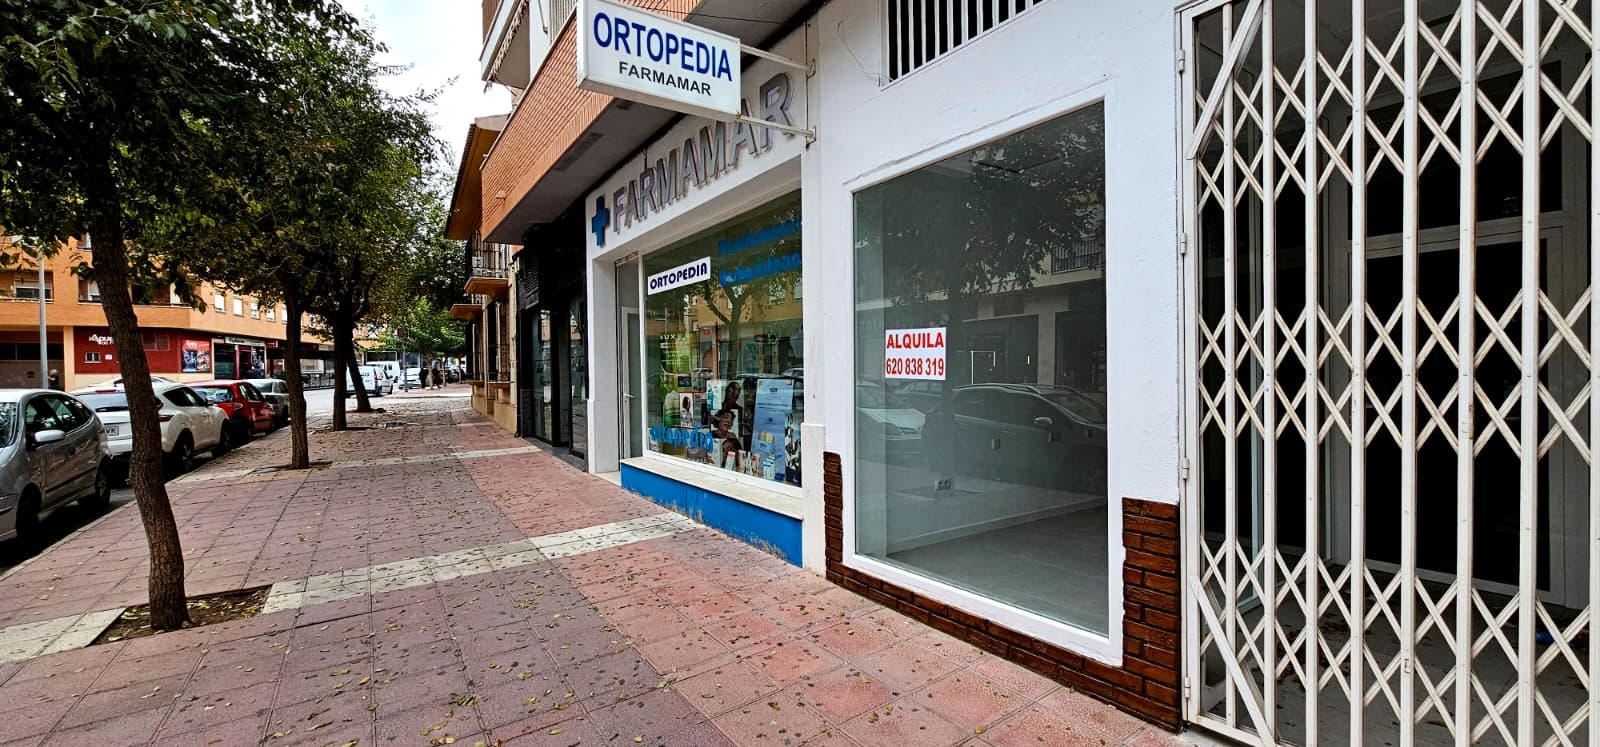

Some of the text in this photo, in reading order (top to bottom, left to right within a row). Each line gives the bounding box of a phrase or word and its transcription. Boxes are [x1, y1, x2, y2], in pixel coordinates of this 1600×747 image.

[594, 12, 732, 82] ORTOPEDIA
[619, 61, 712, 97] FARMAMAR
[613, 72, 795, 233] FARMAMAR
[649, 262, 708, 290] ORTOPEDIA
[886, 332, 944, 349] ALQUILA
[886, 358, 944, 377] 620 838 319
